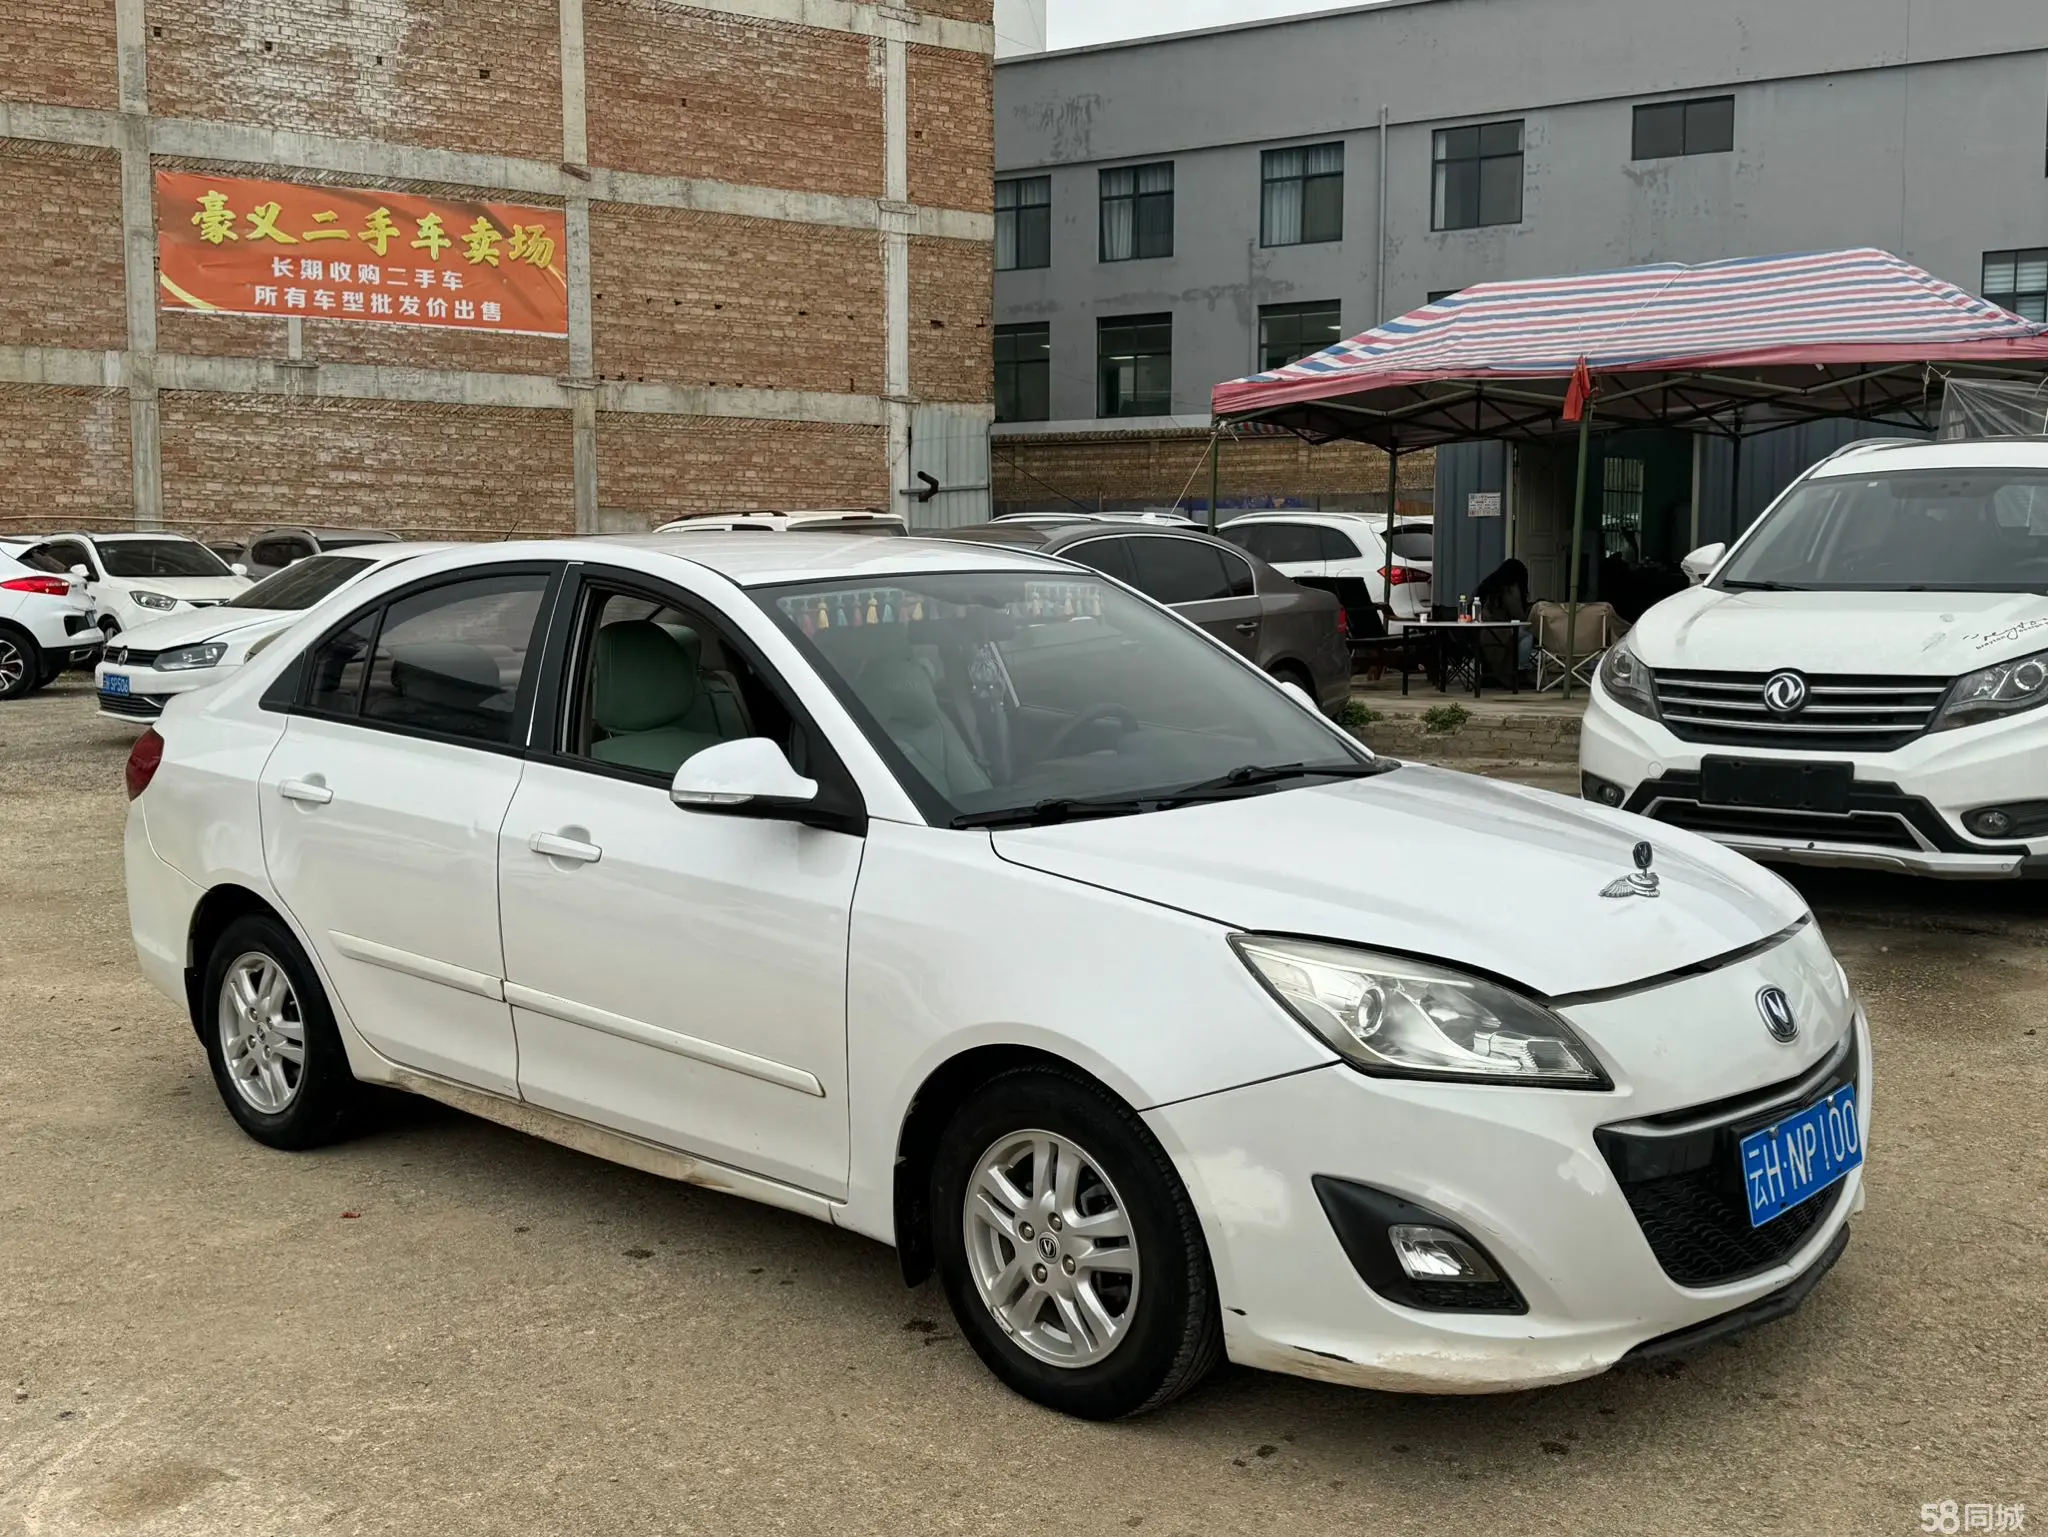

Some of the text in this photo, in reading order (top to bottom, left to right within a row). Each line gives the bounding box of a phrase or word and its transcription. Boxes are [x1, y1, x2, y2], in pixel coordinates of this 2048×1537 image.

[190, 190, 556, 269] 豪义二手车卖场
[271, 256, 464, 291] 长期收购二手车
[254, 285, 502, 321] 所有车型批发价出售
